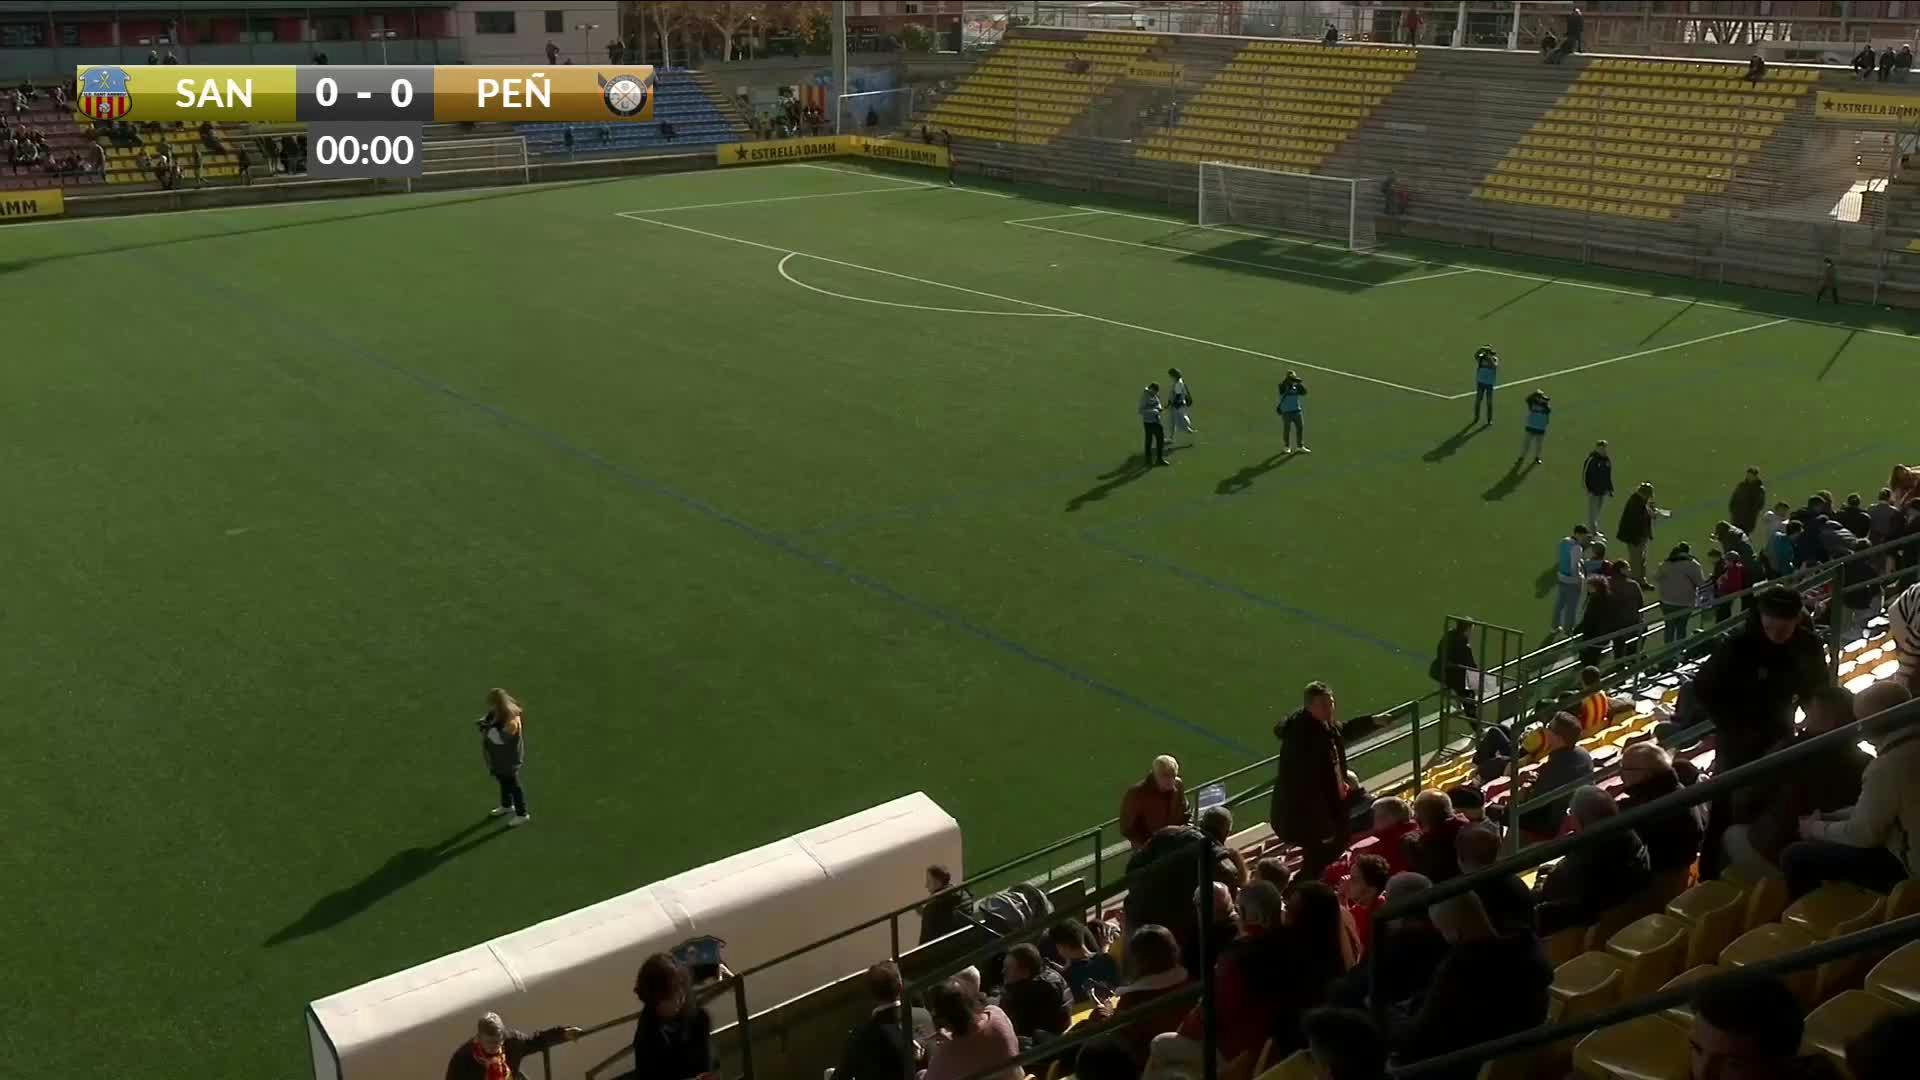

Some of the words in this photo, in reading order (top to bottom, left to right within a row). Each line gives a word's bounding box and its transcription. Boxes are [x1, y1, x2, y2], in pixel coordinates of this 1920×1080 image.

[1837, 103, 1886, 115] ESTRELLA
[751, 145, 802, 160] ESTRELLA
[804, 143, 836, 155] DAMM
